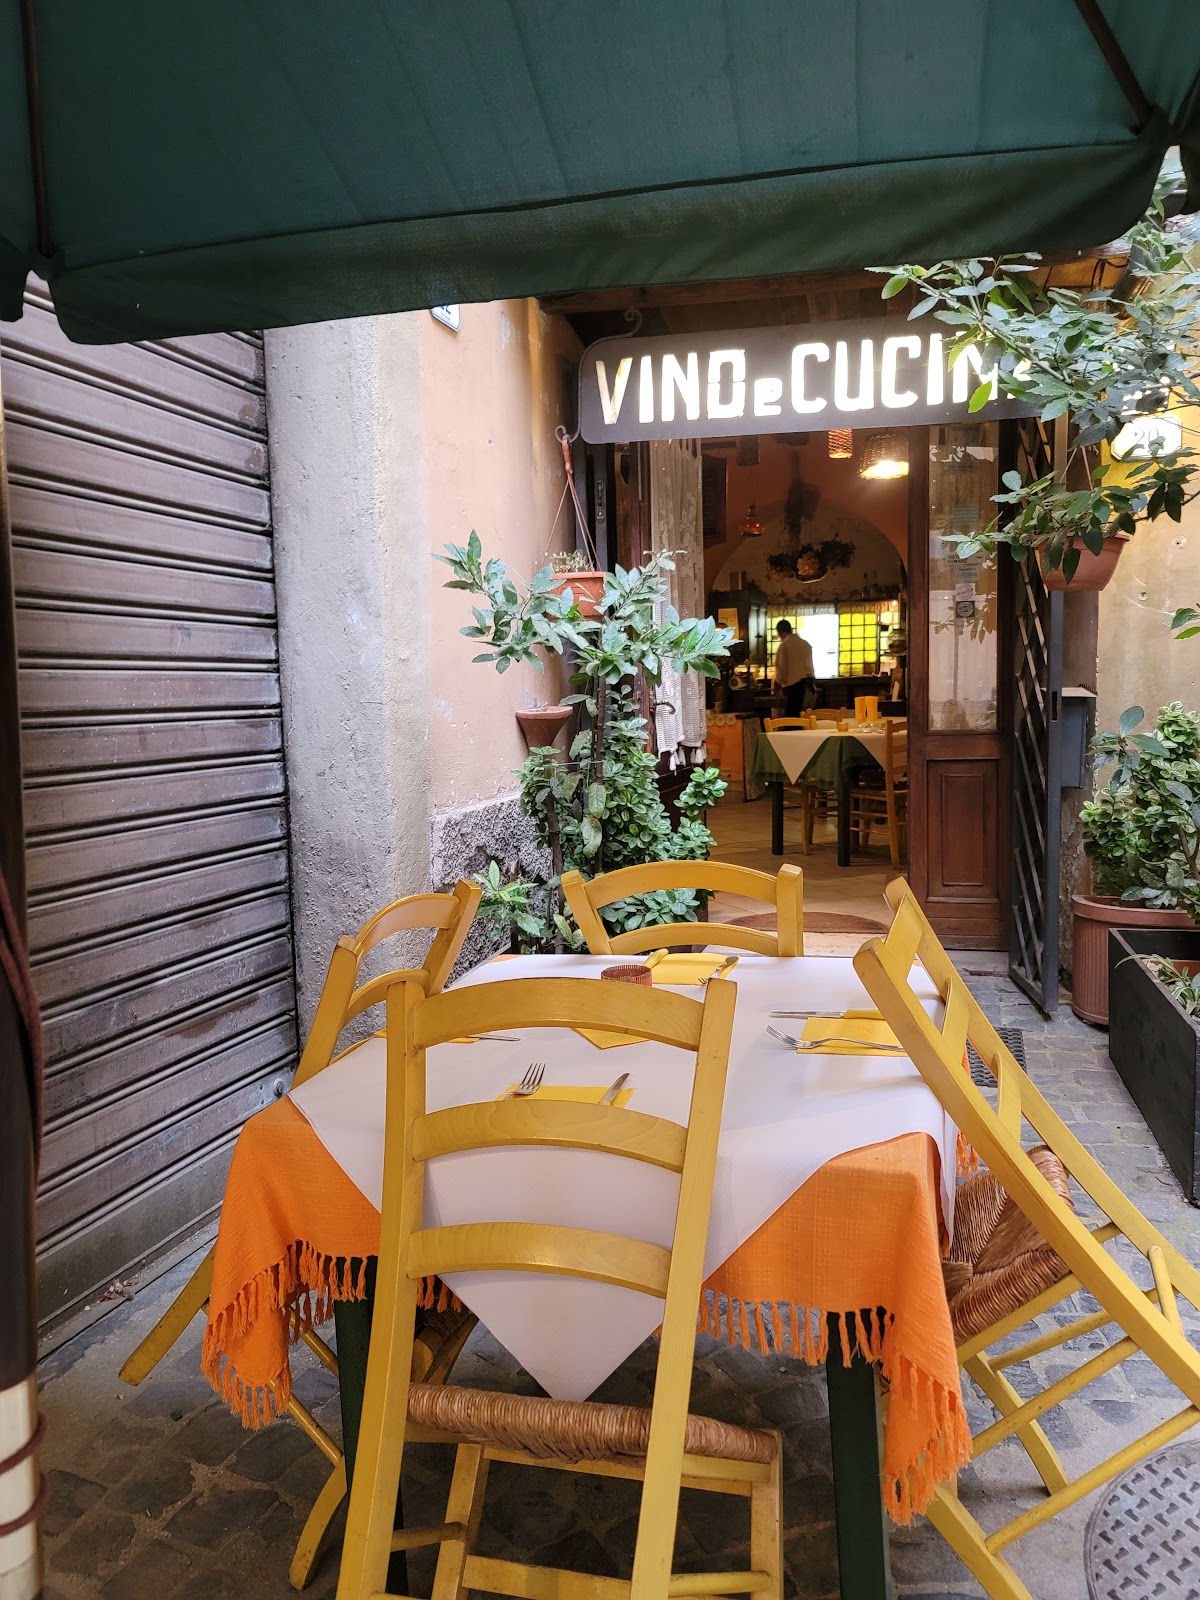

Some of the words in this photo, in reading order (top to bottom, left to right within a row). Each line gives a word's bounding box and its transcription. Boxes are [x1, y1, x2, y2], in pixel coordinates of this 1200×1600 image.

[596, 349, 746, 425] VINO
[753, 377, 783, 417] e
[791, 330, 1034, 414] CUCIN
